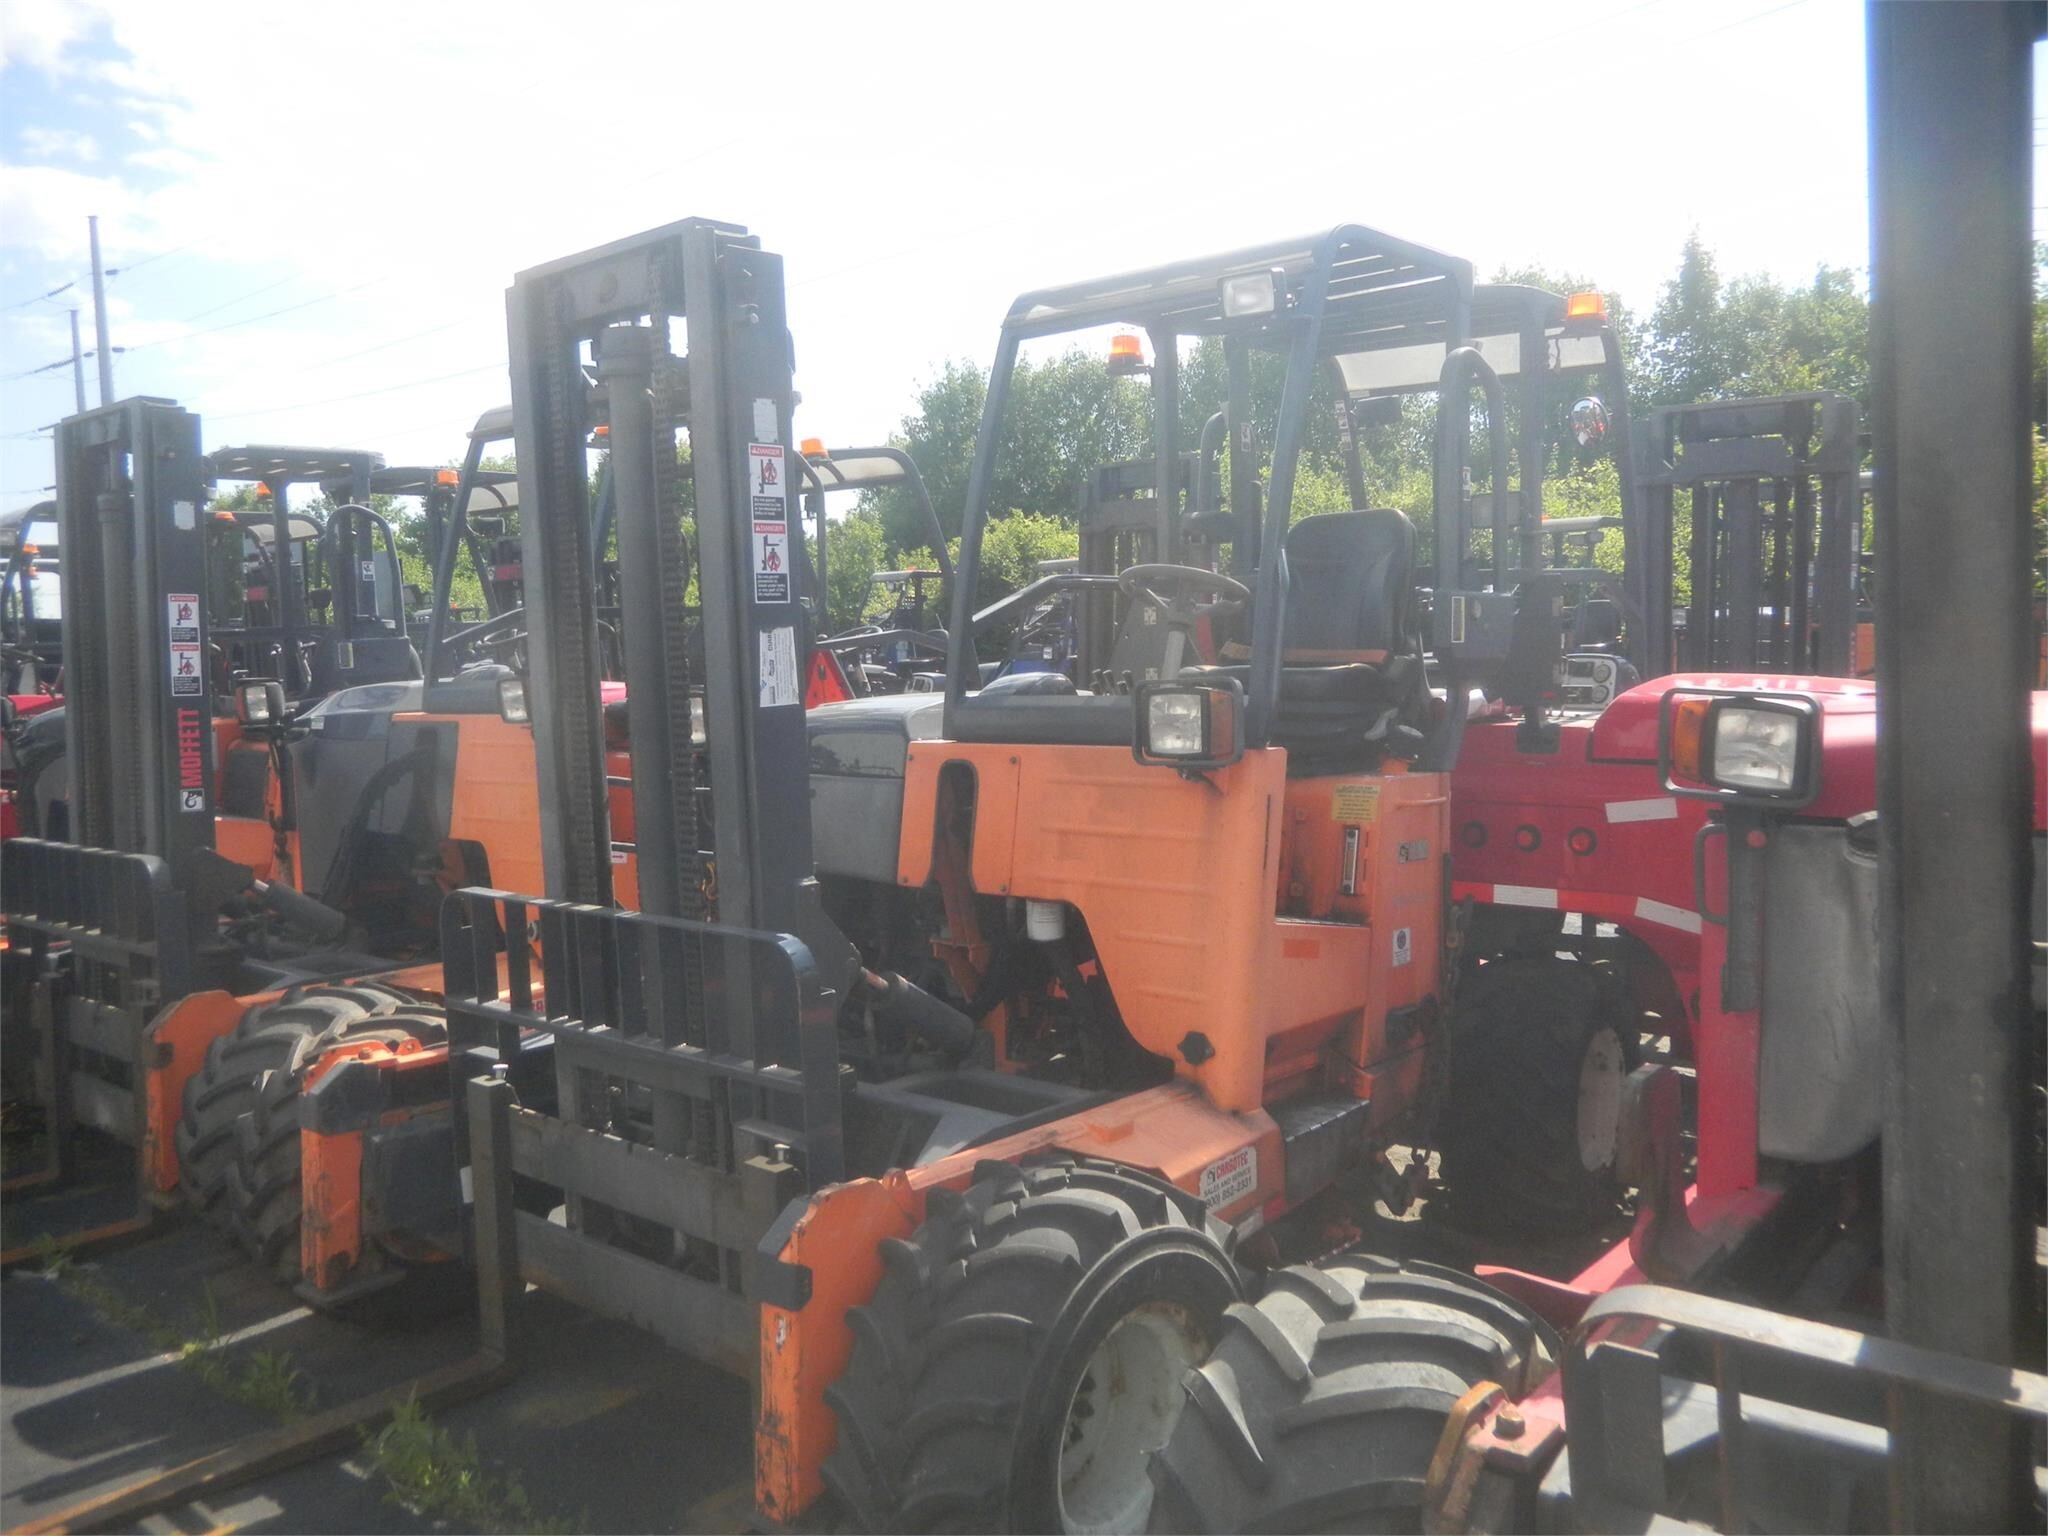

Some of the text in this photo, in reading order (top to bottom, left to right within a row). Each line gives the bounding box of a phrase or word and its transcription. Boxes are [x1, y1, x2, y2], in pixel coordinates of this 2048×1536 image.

[177, 707, 203, 787] MOFFETT
[1216, 1151, 1249, 1180] CARGOTEC
[1204, 1183, 1220, 1197] SALES
[1220, 1178, 1232, 1187] AND
